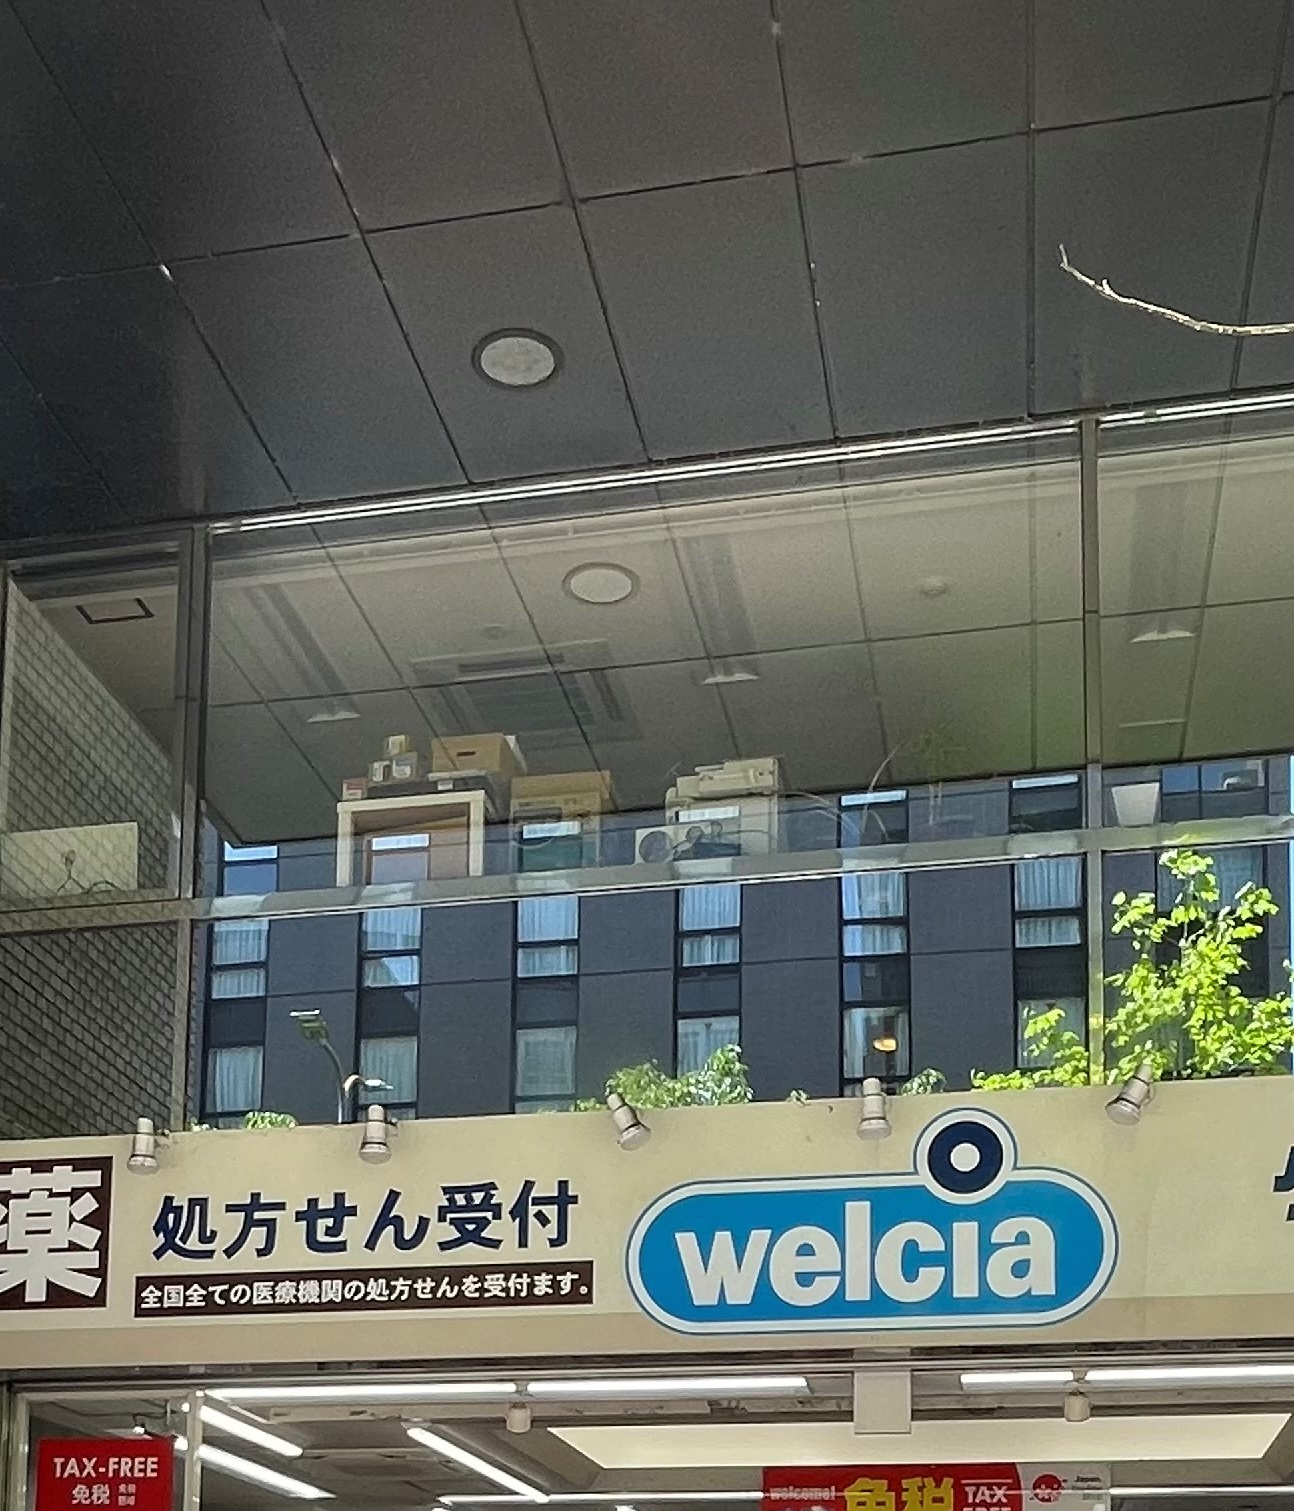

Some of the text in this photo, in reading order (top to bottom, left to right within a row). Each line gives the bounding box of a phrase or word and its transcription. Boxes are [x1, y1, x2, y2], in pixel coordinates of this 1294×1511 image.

[152, 1178, 579, 1260] 処方せん受付
[674, 1120, 1056, 1307] welcia
[53, 1456, 159, 1479] TAX-FREE
[72, 1484, 111, 1506] 免税
[963, 1484, 1009, 1504] TAX
